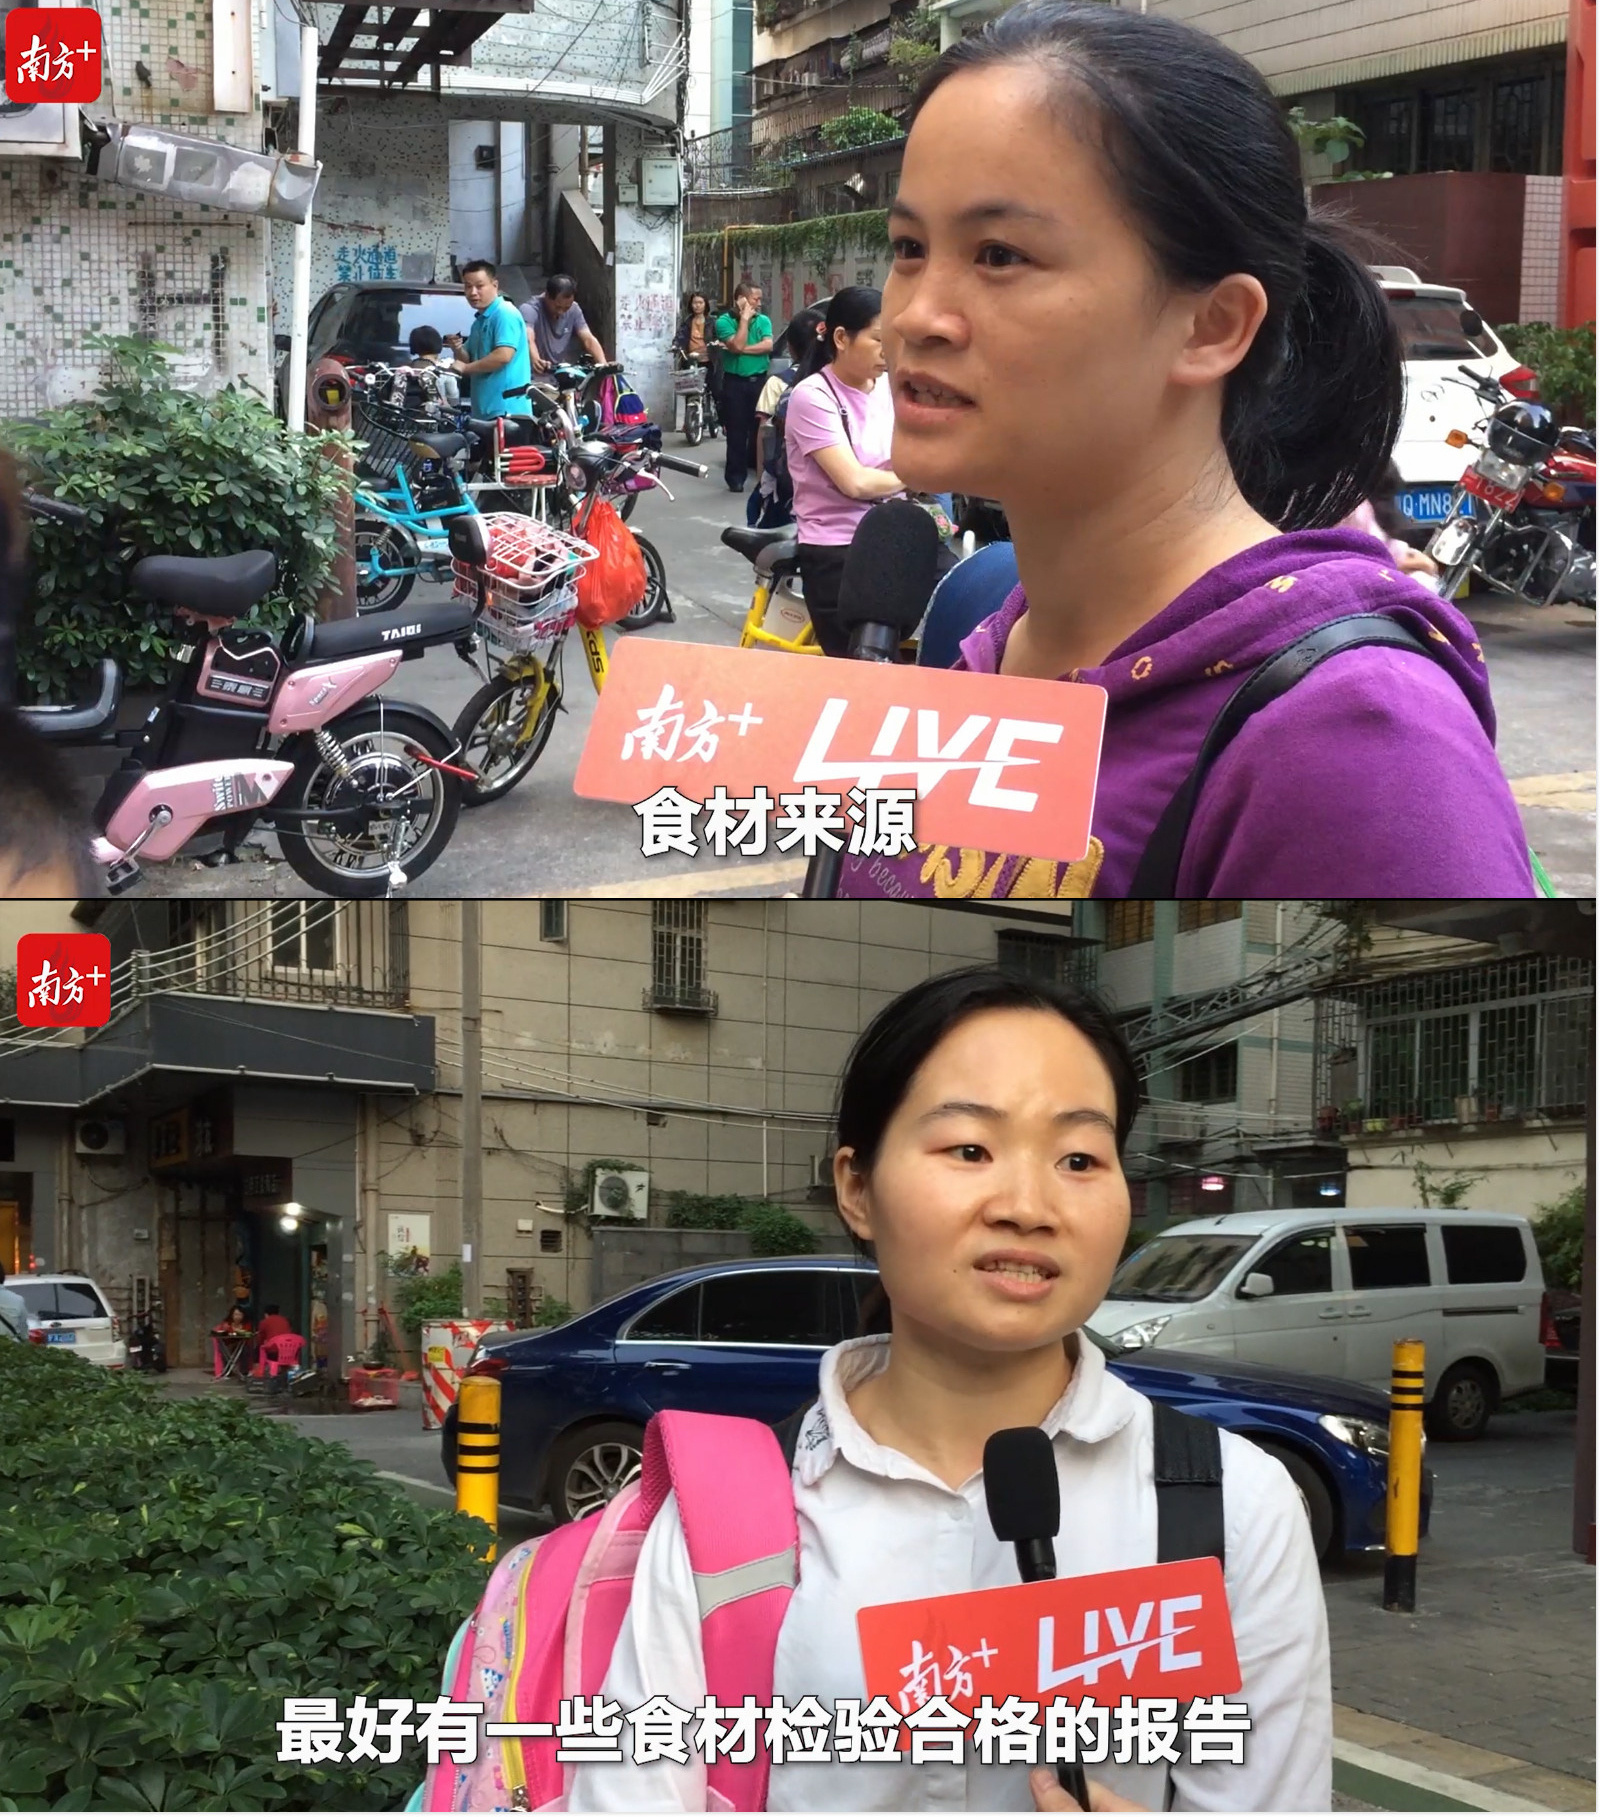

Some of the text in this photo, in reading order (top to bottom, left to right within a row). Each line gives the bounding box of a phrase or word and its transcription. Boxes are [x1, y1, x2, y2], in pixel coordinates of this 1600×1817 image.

[621, 683, 764, 763] 南方+
[794, 698, 1061, 813] LIVE
[1037, 1594, 1202, 1693] LIVE
